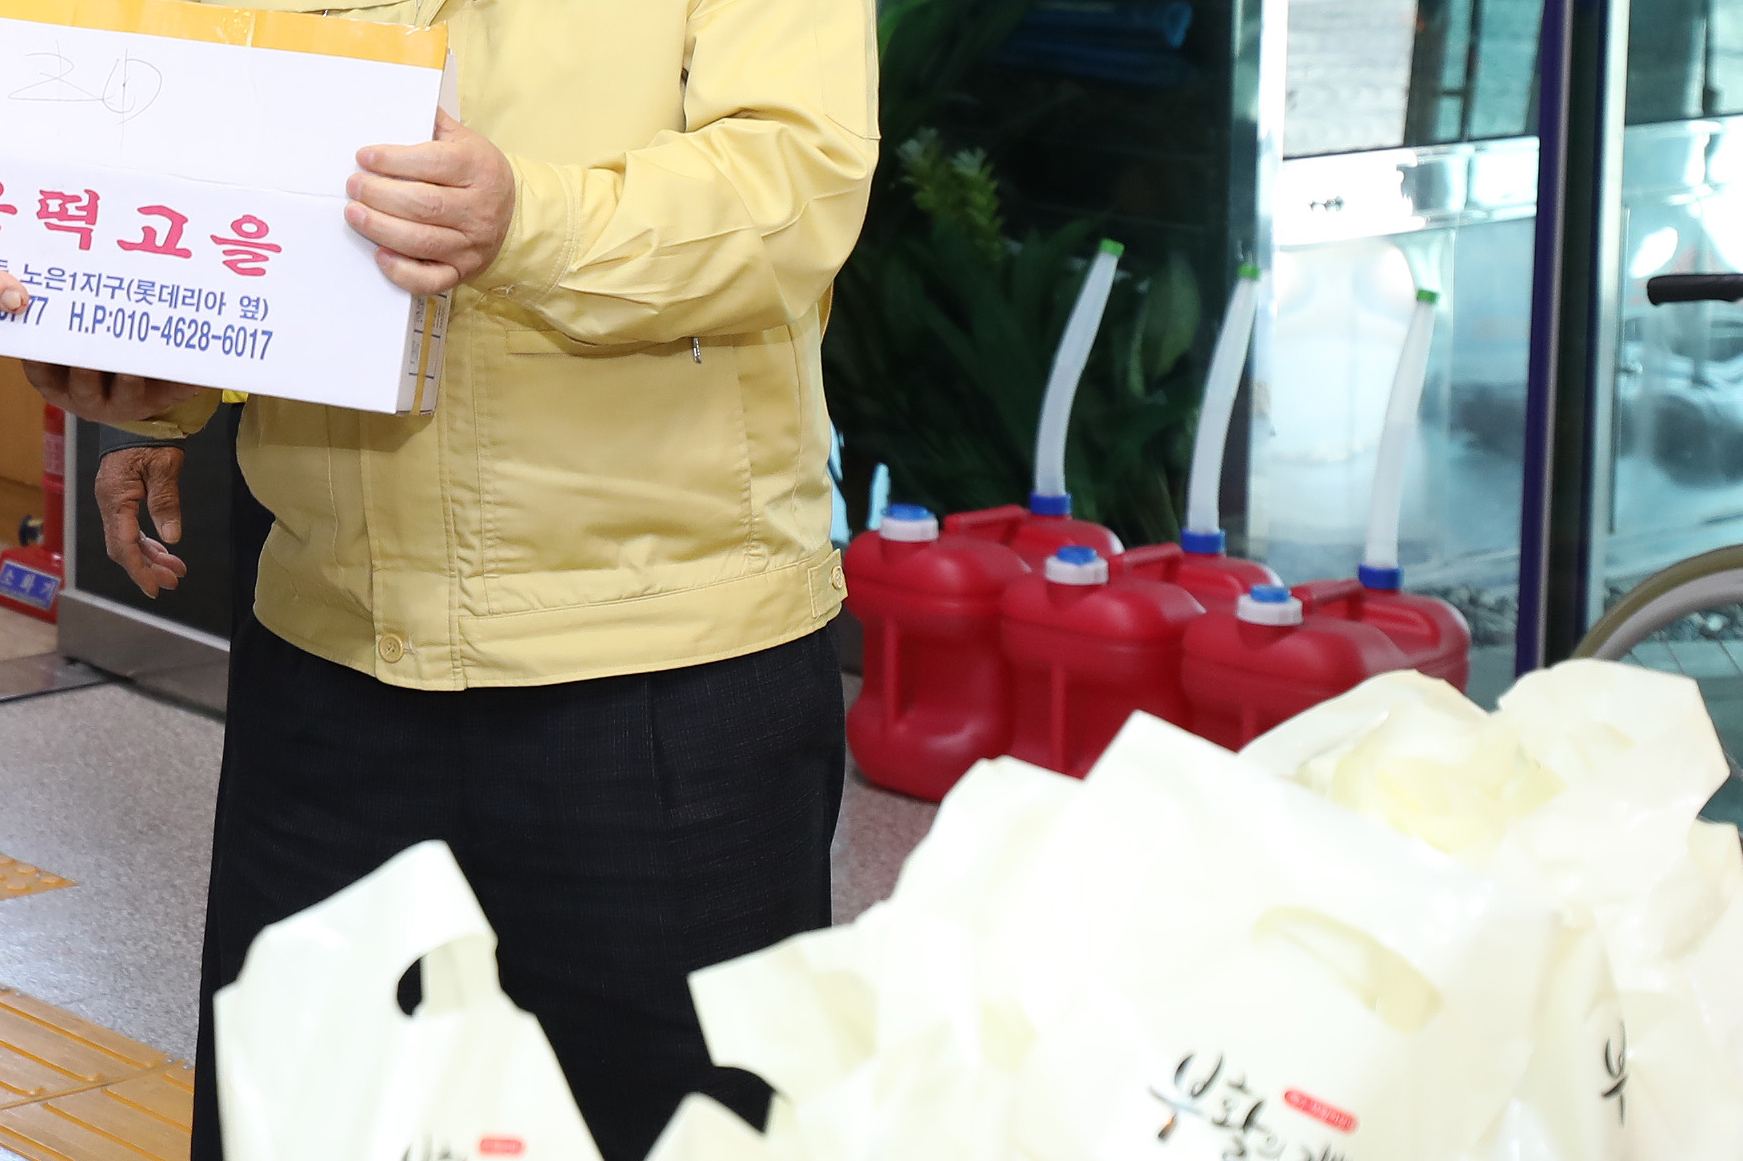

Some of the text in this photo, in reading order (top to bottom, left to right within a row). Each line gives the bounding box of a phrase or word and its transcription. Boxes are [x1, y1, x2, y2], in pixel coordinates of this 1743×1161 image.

[21, 262, 227, 318] 노은1지구(롯데리아
[238, 293, 269, 323] 옆)
[67, 300, 274, 361] H.P:010-4628-6017
